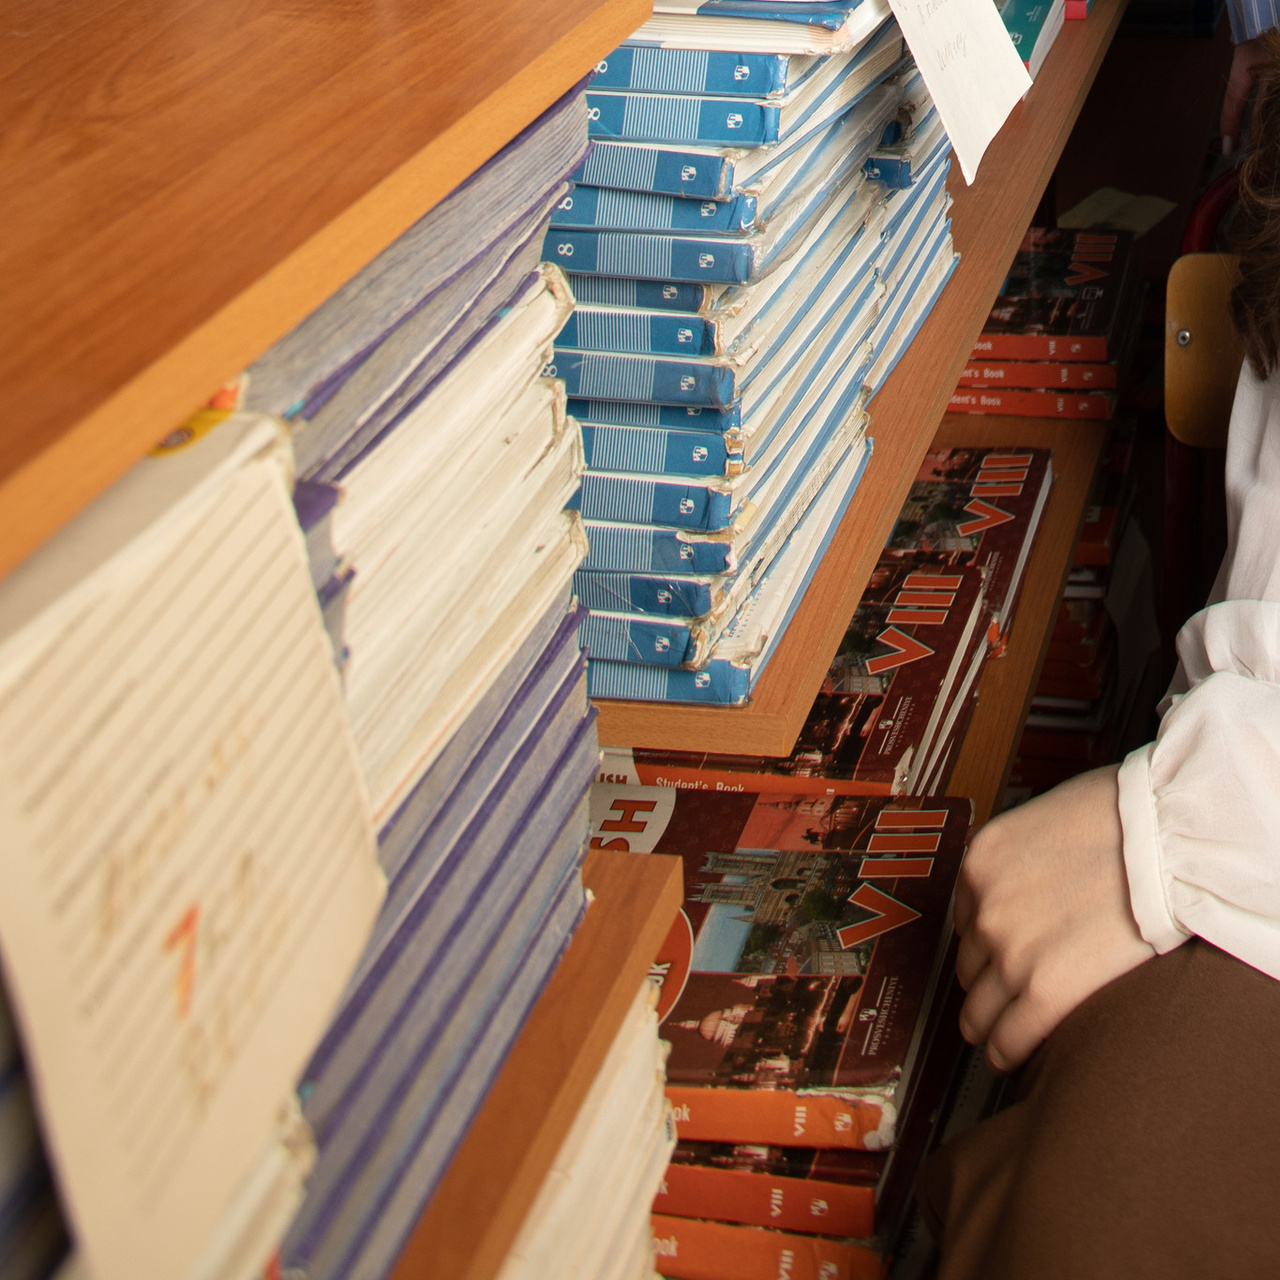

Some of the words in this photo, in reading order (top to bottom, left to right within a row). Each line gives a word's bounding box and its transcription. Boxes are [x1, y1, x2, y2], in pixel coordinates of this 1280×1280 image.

[557, 243, 574, 256] 8
[984, 368, 1005, 378] Book
[981, 395, 1001, 406] Book
[956, 454, 1033, 537] VIII
[865, 575, 964, 675] VIII
[836, 809, 949, 950] VIII
[794, 1106, 807, 1137] VIII
[771, 1188, 783, 1217] VIII
